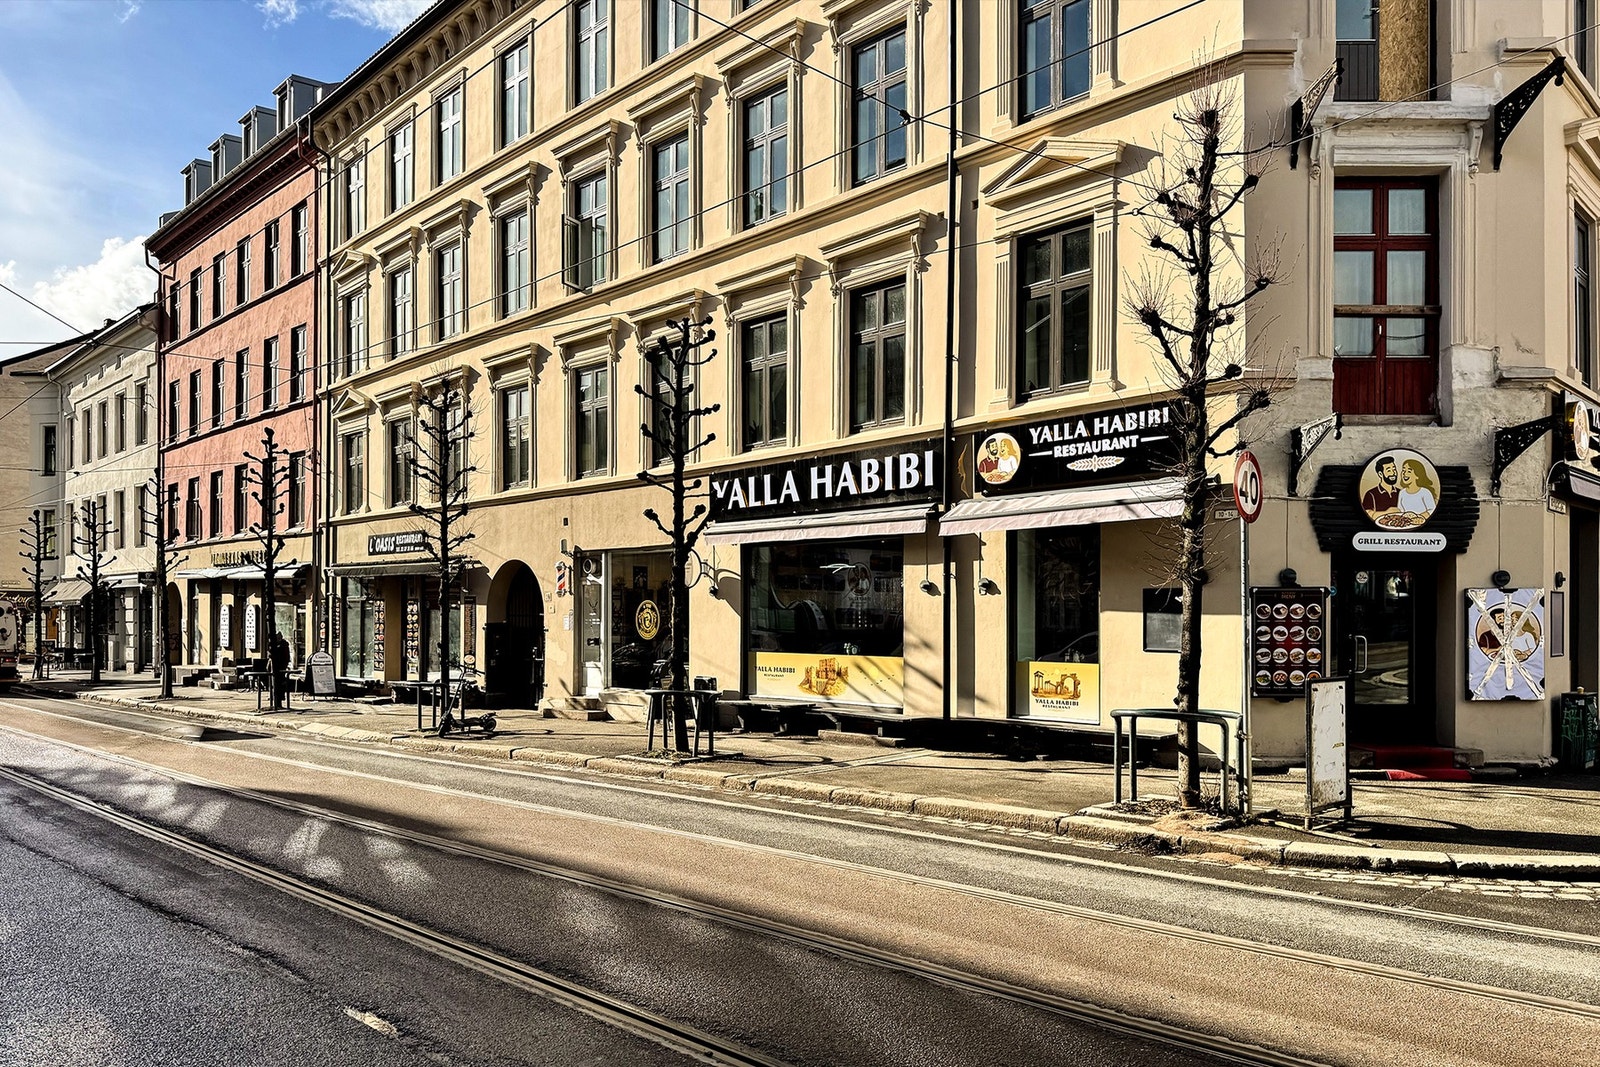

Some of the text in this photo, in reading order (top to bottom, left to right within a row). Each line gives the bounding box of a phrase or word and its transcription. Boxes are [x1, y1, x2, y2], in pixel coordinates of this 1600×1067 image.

[1029, 407, 1169, 444] YALLA HABIBI
[1054, 435, 1139, 458] RESTAURANT
[712, 450, 934, 510] YALLA HABIBI
[1240, 470, 1259, 505] 40
[1358, 537, 1441, 546] GRILL RESTAURANT
